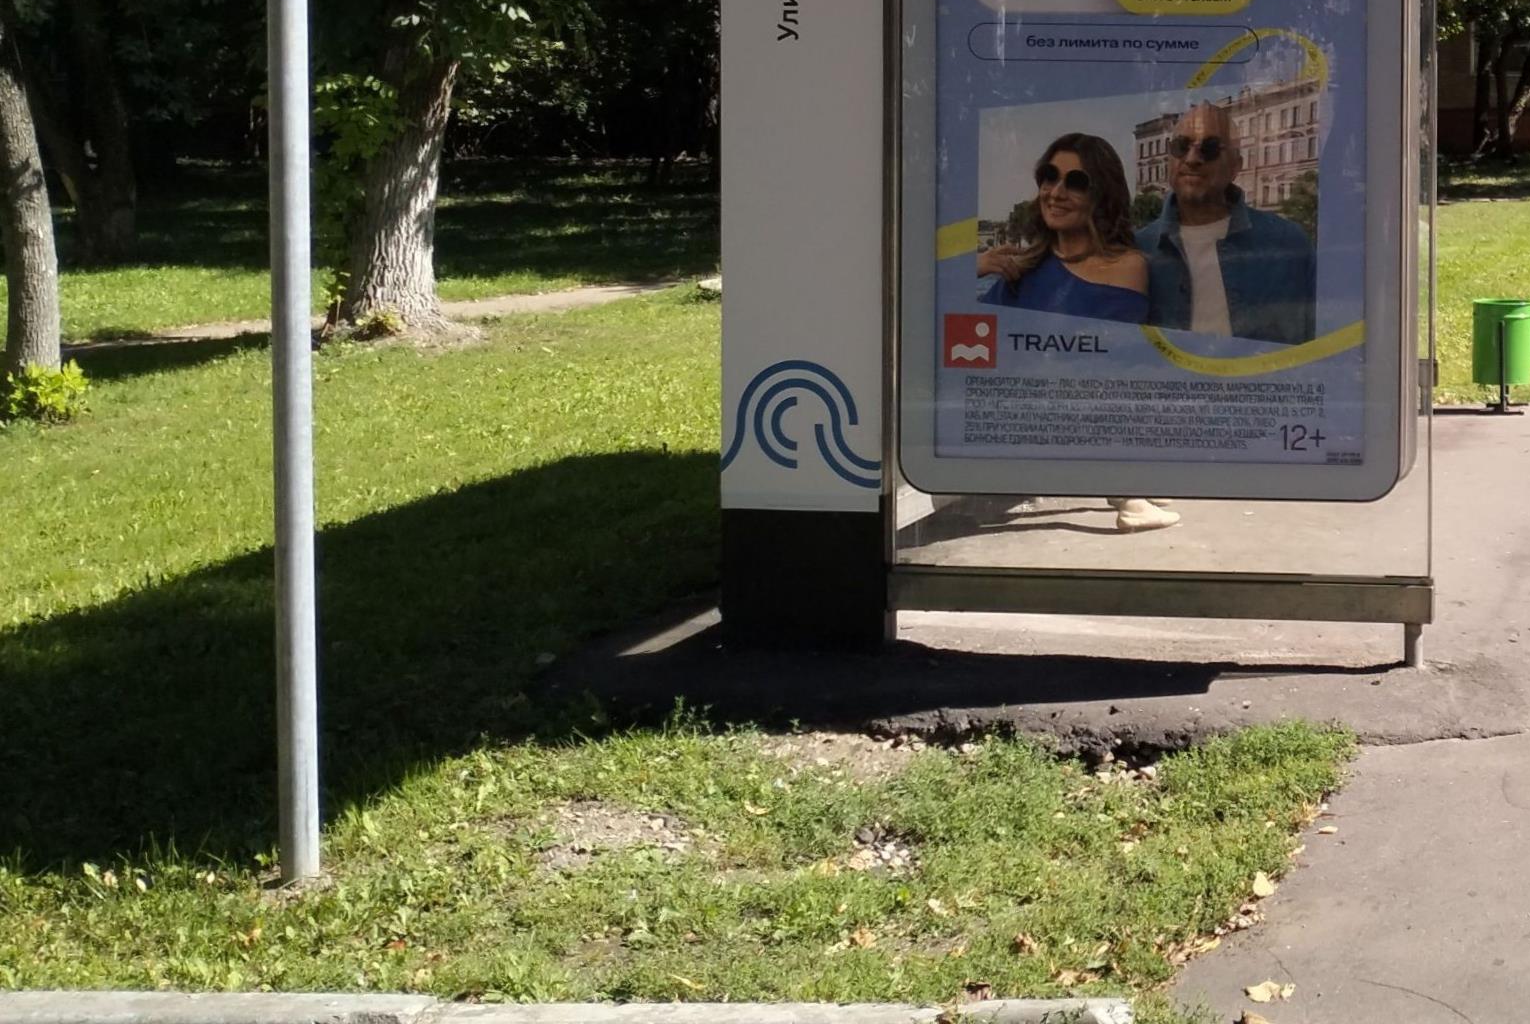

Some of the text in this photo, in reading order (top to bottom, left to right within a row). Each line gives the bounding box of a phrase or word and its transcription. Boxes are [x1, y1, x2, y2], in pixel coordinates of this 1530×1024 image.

[1026, 35, 1056, 49] без
[1058, 38, 1119, 50] лимита
[1122, 38, 1144, 50] по
[1146, 39, 1200, 53] сумме
[1007, 333, 1109, 354] TRAVEL
[1279, 424, 1327, 451] 12+
